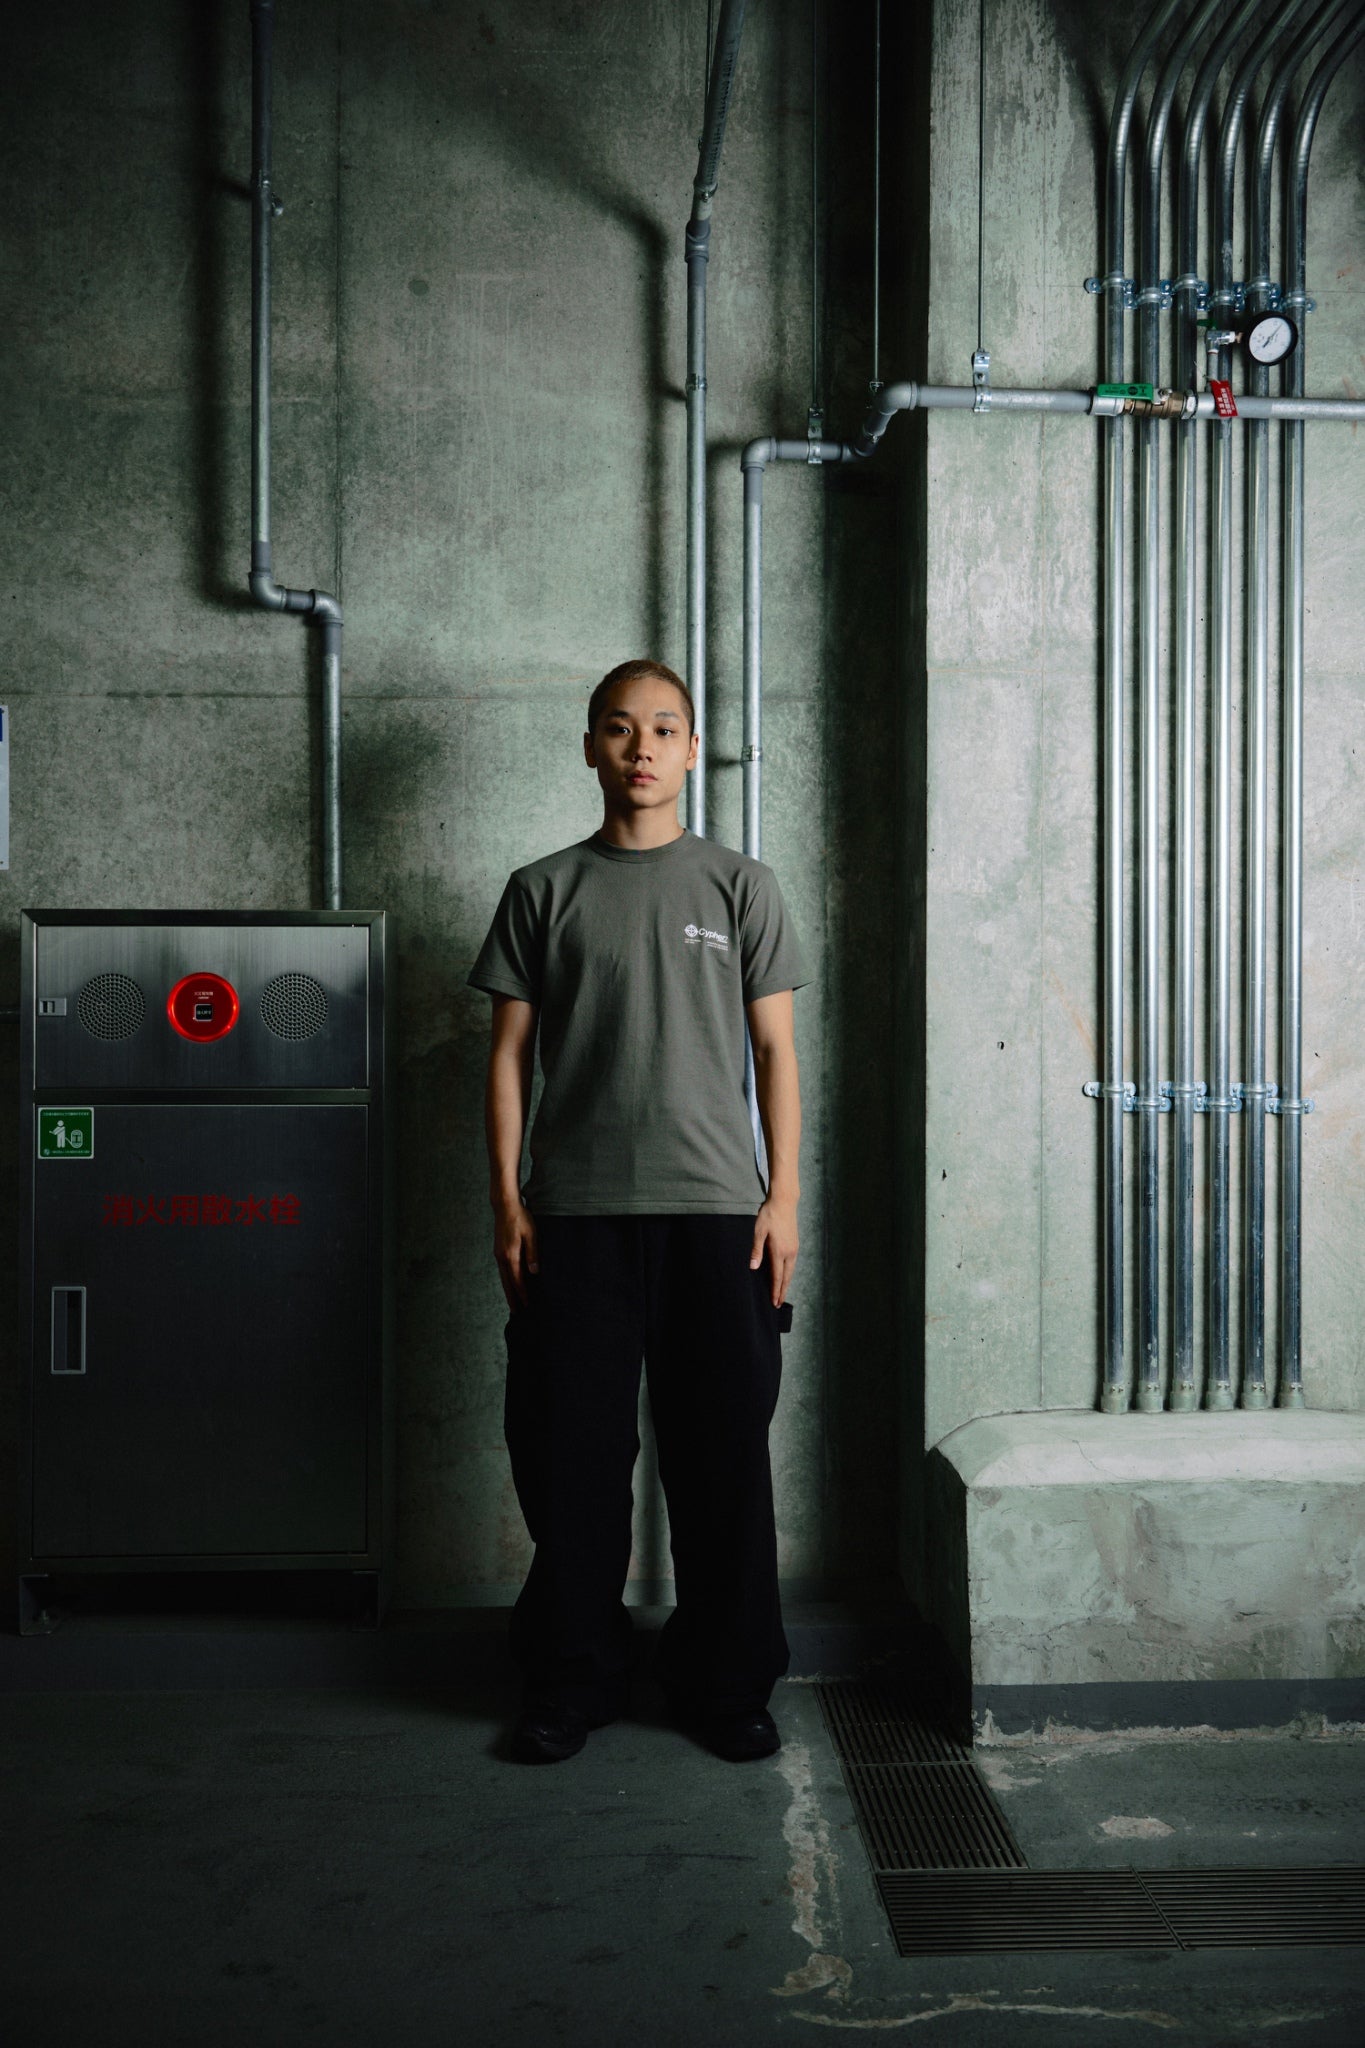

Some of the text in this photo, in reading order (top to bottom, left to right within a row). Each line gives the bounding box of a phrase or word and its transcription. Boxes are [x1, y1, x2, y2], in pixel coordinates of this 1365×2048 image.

[102, 1193, 301, 1227] 消火用散水栓
